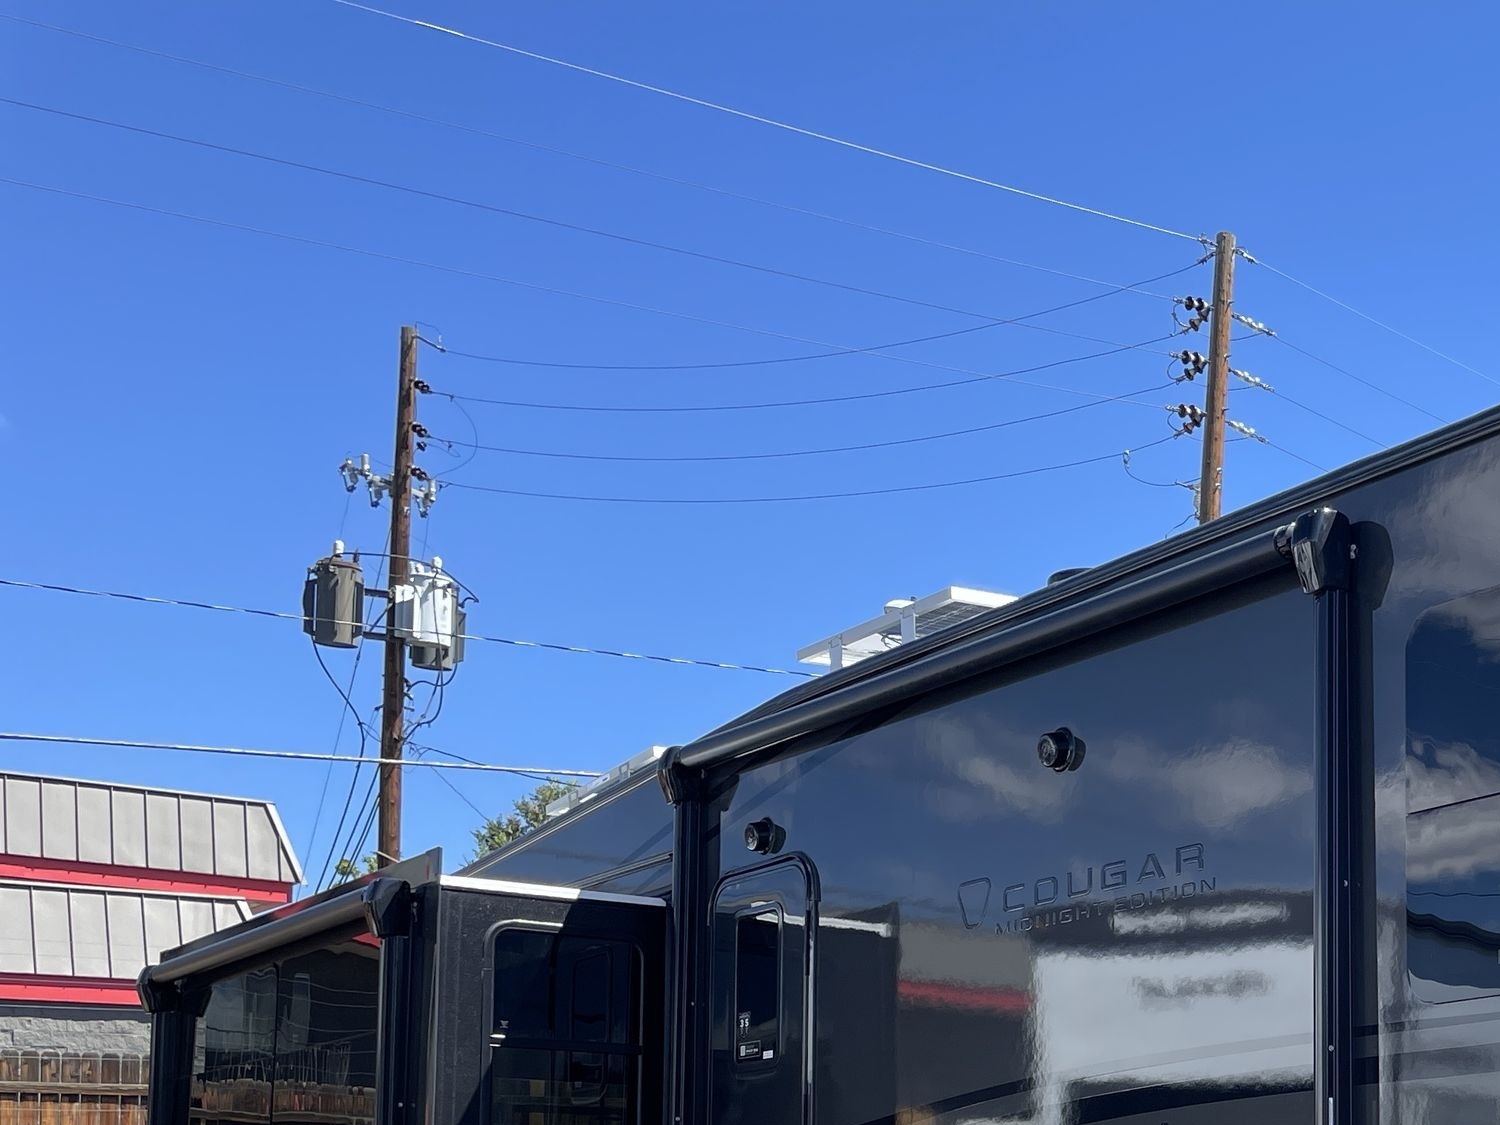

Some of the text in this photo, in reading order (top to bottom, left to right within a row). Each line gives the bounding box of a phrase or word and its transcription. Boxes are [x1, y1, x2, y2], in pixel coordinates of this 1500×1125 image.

[994, 876, 1218, 937] MIDNIGHT EDITION
[1002, 842, 1205, 914] COUGAR
